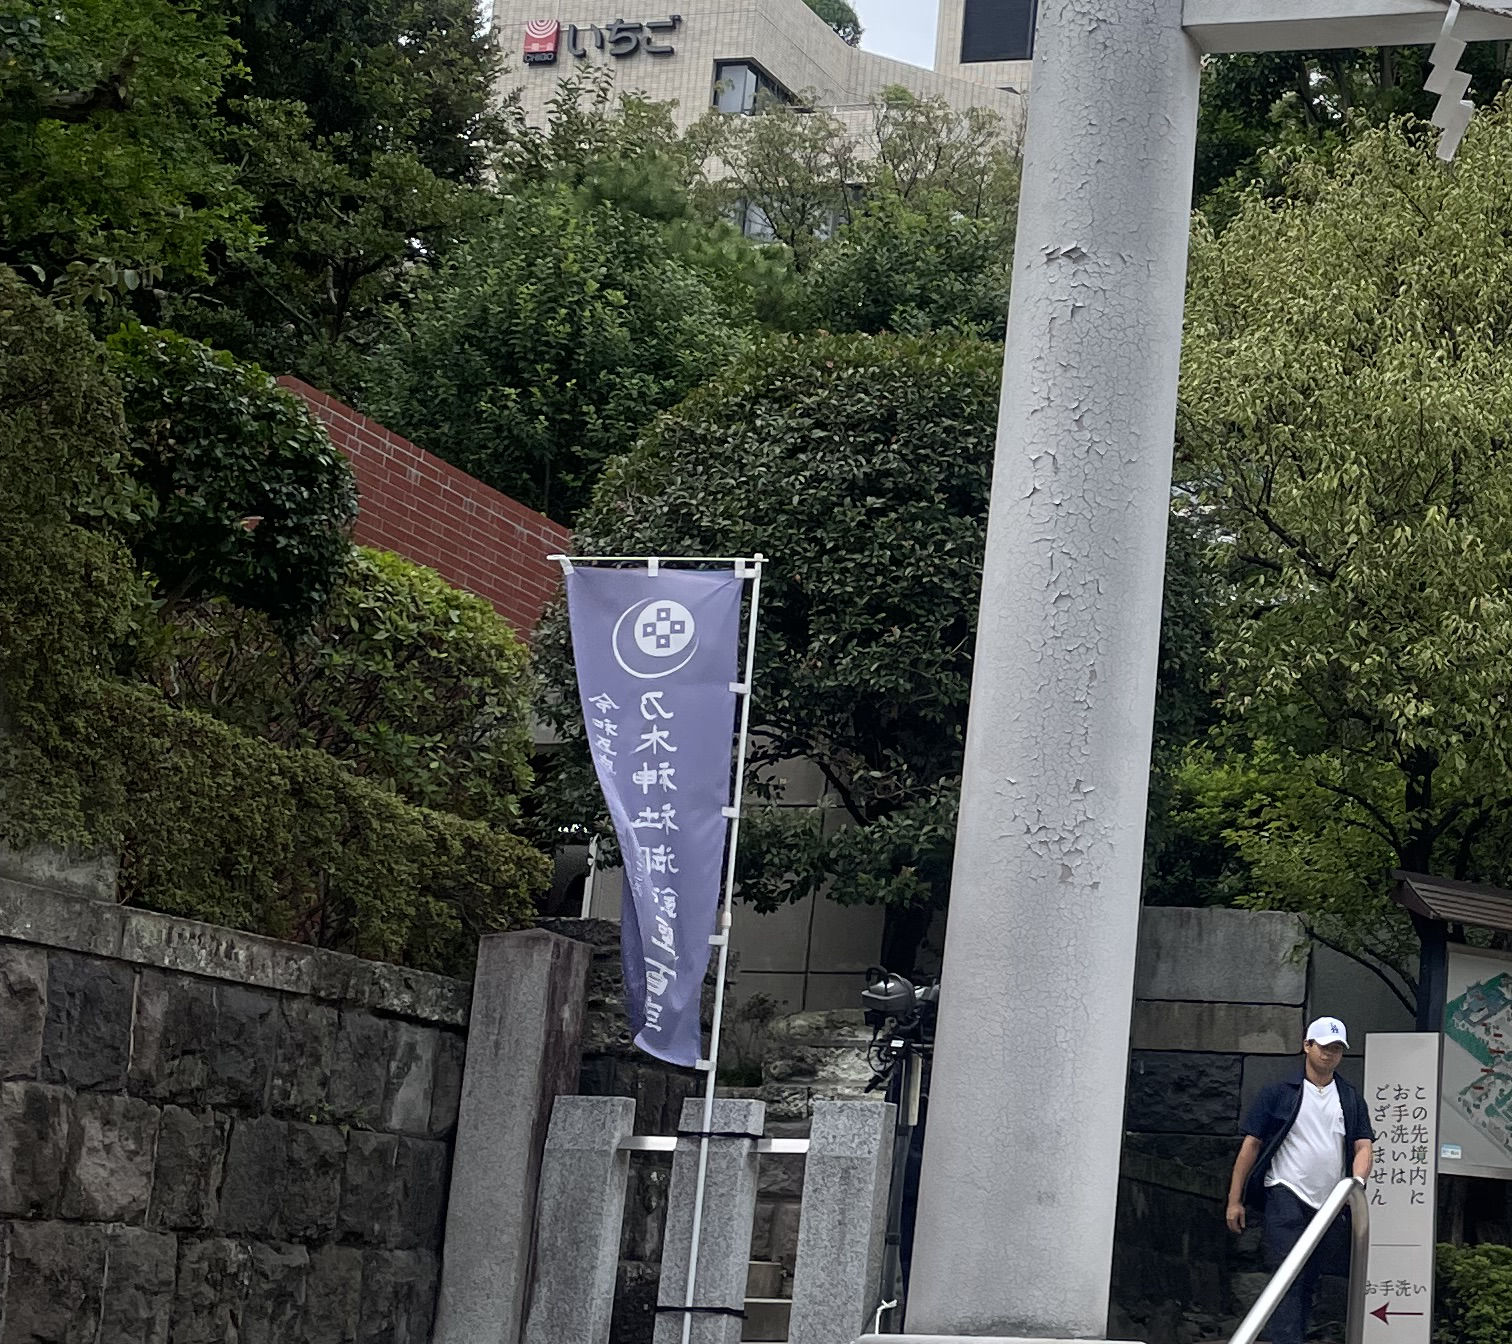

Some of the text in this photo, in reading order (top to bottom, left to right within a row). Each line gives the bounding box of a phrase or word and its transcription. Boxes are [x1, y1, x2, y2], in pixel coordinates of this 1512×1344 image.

[567, 15, 683, 58] いちご
[1370, 1084, 1390, 1206] ございません
[1390, 1083, 1409, 1186] お手洗いは
[1409, 1086, 1429, 1206] この先境内に
[1365, 1279, 1428, 1297] お手洗い
